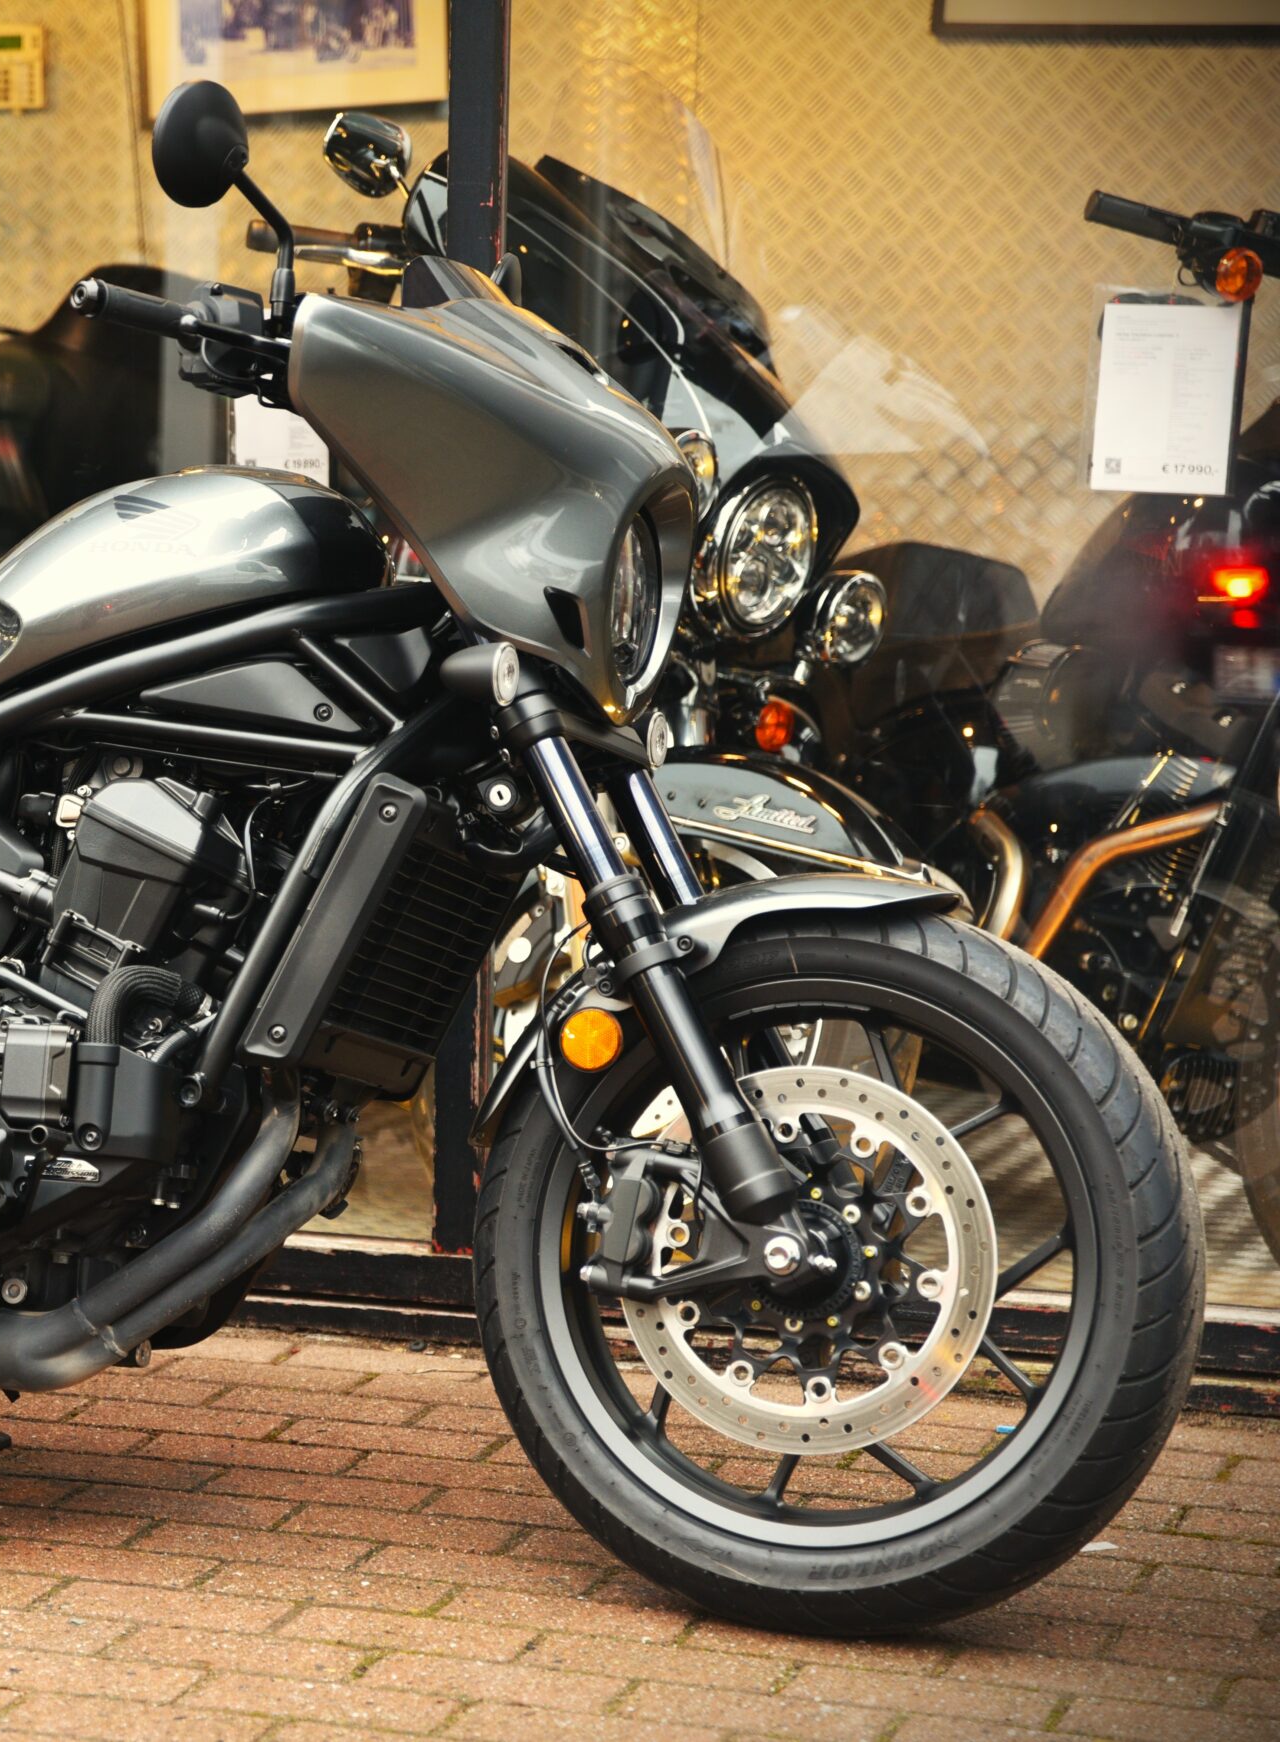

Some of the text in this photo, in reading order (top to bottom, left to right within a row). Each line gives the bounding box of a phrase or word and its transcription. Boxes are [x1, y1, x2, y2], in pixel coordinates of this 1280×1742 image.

[1162, 464, 1170, 474] €
[89, 540, 197, 558] HONDA
[807, 1544, 938, 1580] DUNLOP
